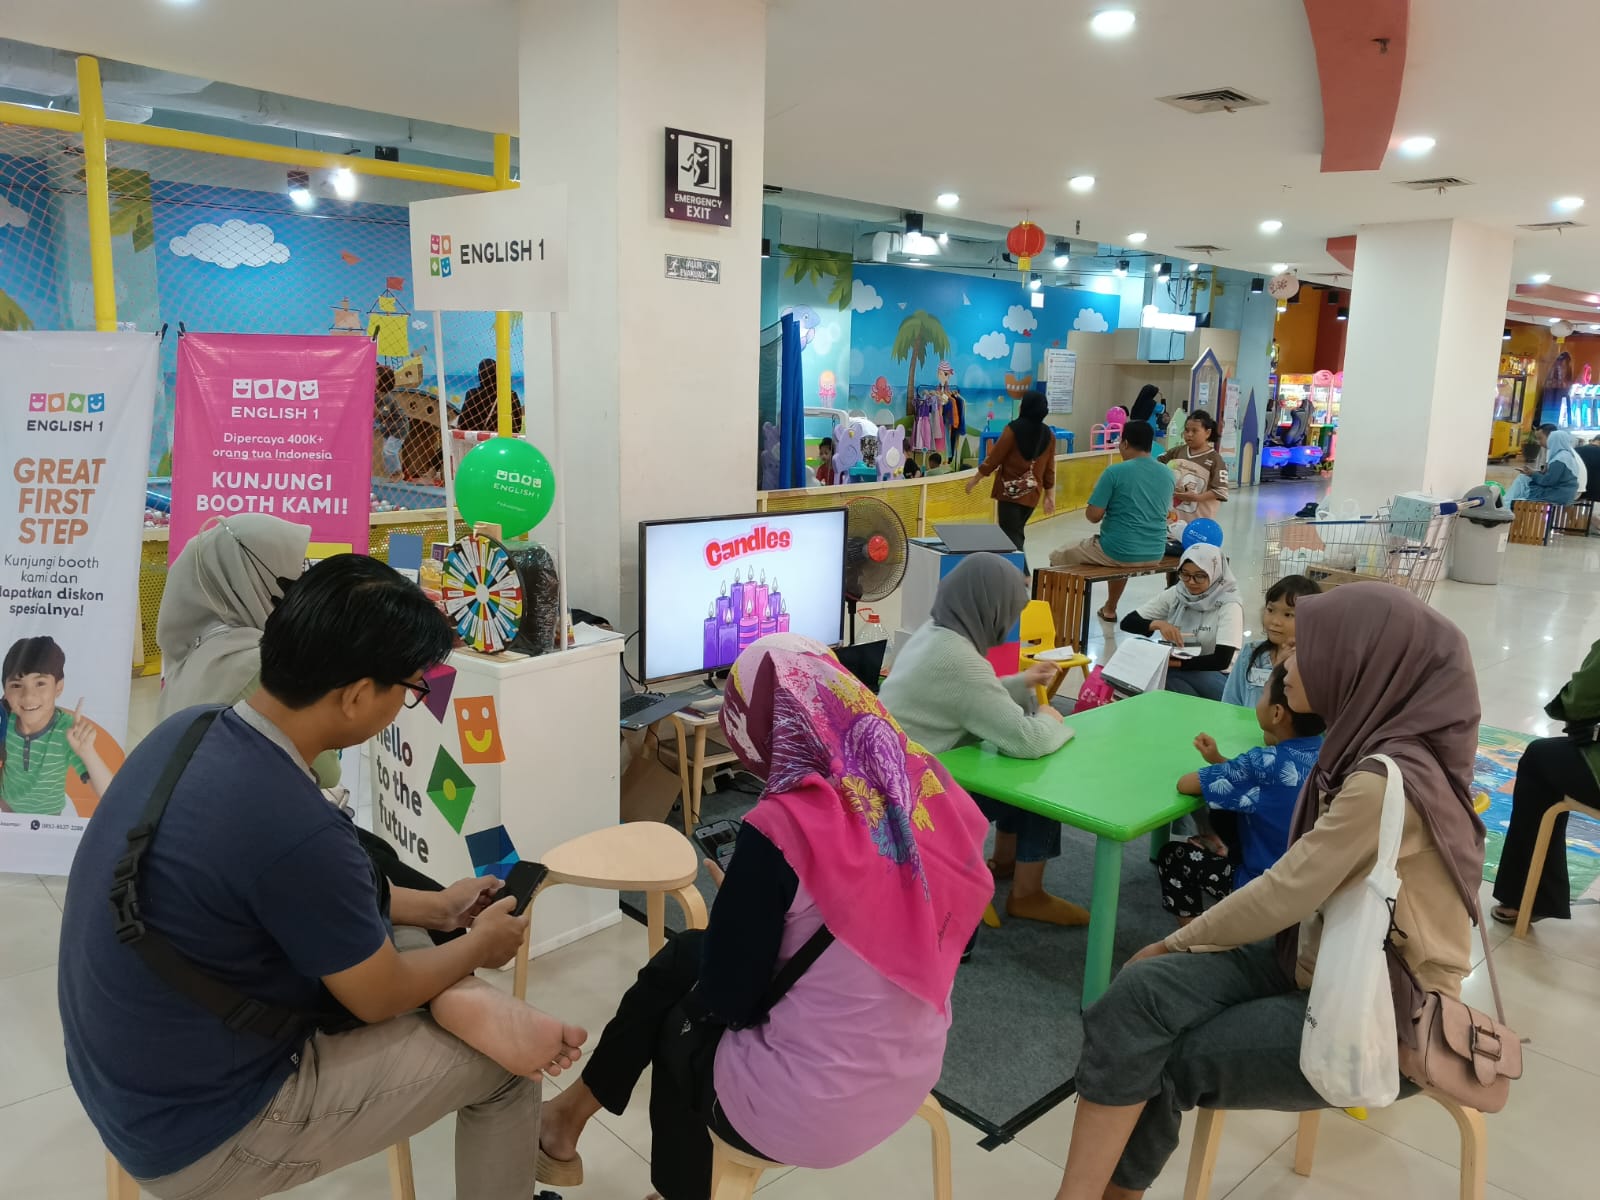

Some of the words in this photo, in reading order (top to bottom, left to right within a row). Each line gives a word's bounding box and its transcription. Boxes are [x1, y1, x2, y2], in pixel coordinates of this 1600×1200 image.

[674, 193, 722, 209] EMERGENCY
[686, 206, 712, 220] EXIT
[460, 239, 532, 265] ENGLISH
[538, 238, 545, 261] 1
[231, 406, 307, 419] ENGLISH
[312, 408, 319, 420] 1
[27, 420, 93, 432] ENGLISH
[98, 421, 104, 432] 1
[223, 432, 285, 446] Dipercaya
[287, 434, 324, 445] 400K+
[212, 448, 249, 461] orang
[251, 449, 272, 459] tua
[275, 449, 333, 461] Indonesia
[13, 457, 107, 485] GREAT
[211, 471, 332, 491] KUNJUNGI
[494, 482, 536, 497] ENGLISH
[18, 487, 96, 515] FIRST
[196, 494, 275, 513] BOOTH
[282, 496, 348, 515] KAMI!
[18, 517, 89, 545] STEP
[705, 526, 791, 567] Candles
[4, 553, 56, 570] Kunjungi
[58, 555, 99, 569] booth
[21, 570, 48, 583] kami
[49, 571, 78, 584] dan
[0, 585, 52, 600] apatkan
[57, 587, 104, 601] diskon
[9, 602, 84, 619] spesialnya!
[377, 755, 390, 791] to
[392, 770, 422, 817] the
[378, 793, 429, 864] future
